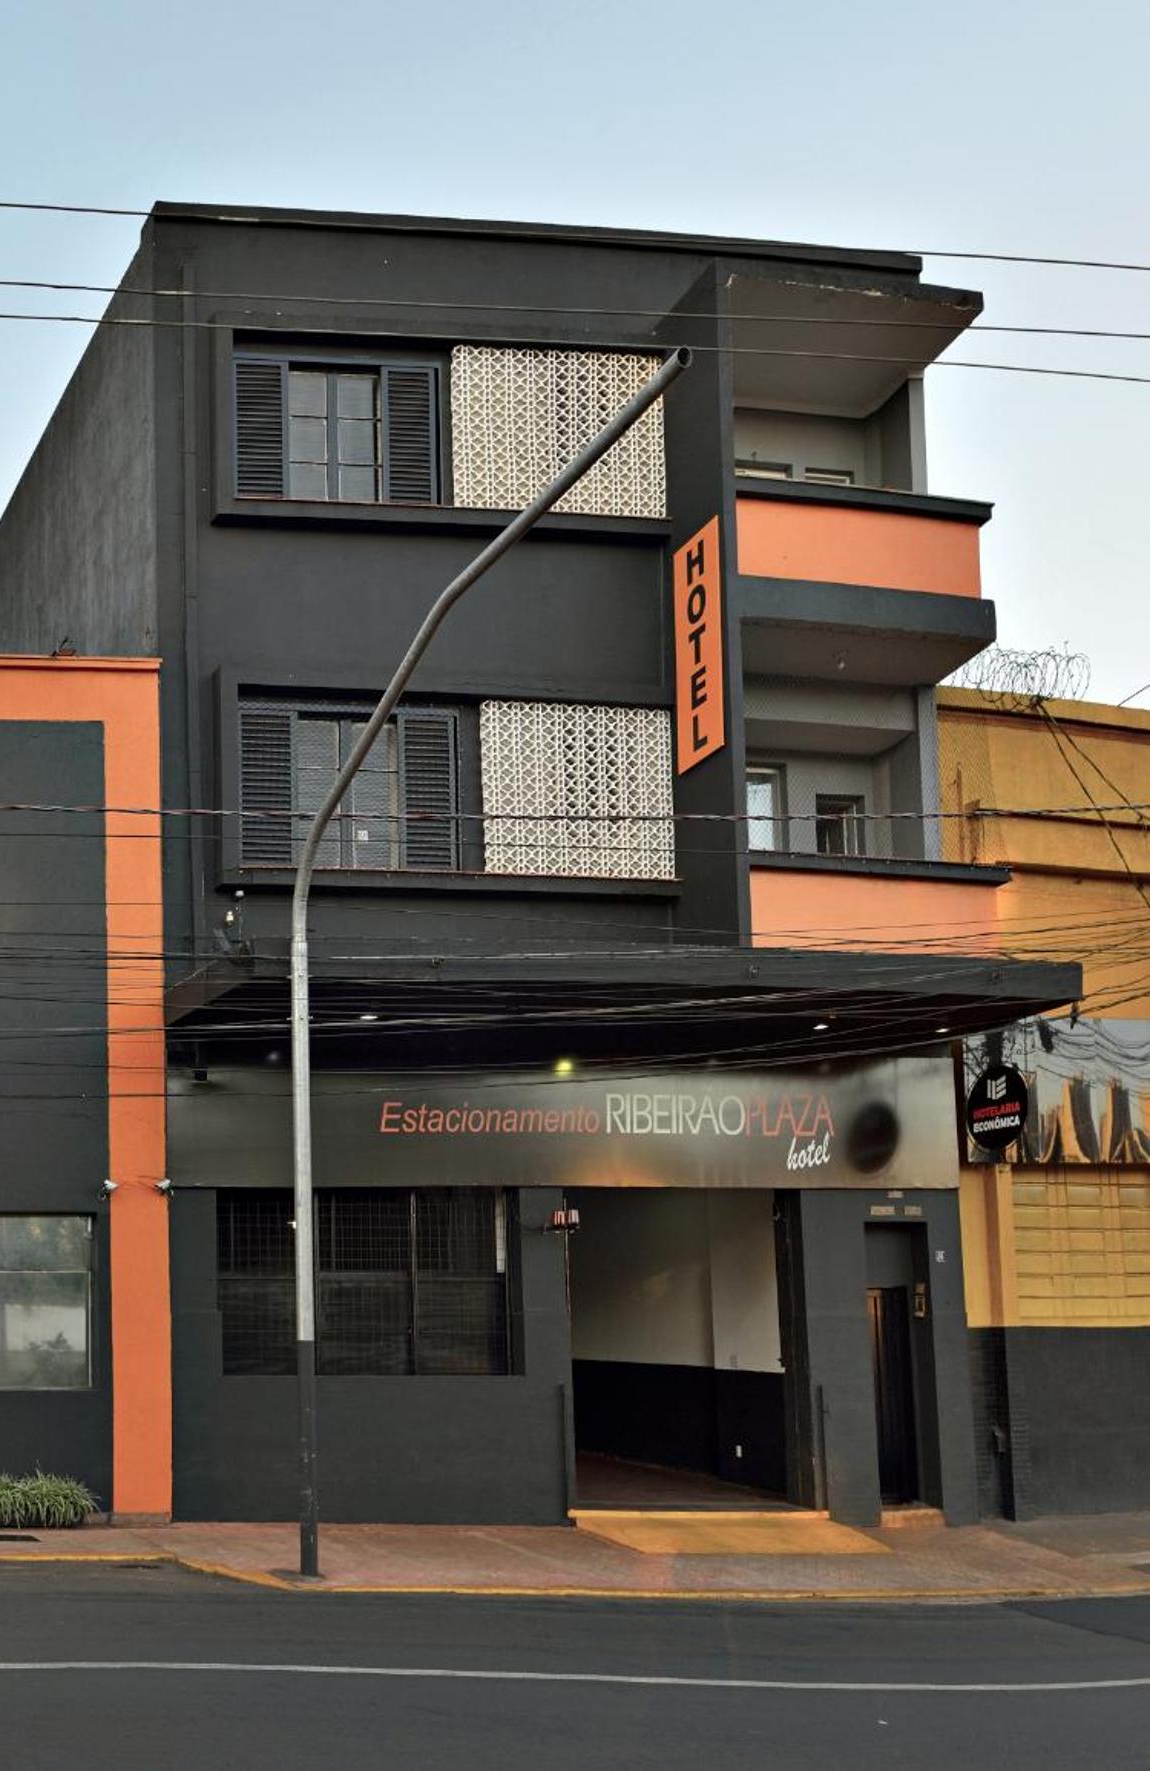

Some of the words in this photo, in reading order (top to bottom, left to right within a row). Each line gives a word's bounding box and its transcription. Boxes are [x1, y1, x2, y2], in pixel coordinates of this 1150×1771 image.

[686, 539, 708, 752] HOTEL
[380, 1100, 600, 1134] Estacionamento
[787, 1131, 831, 1171] hotel
